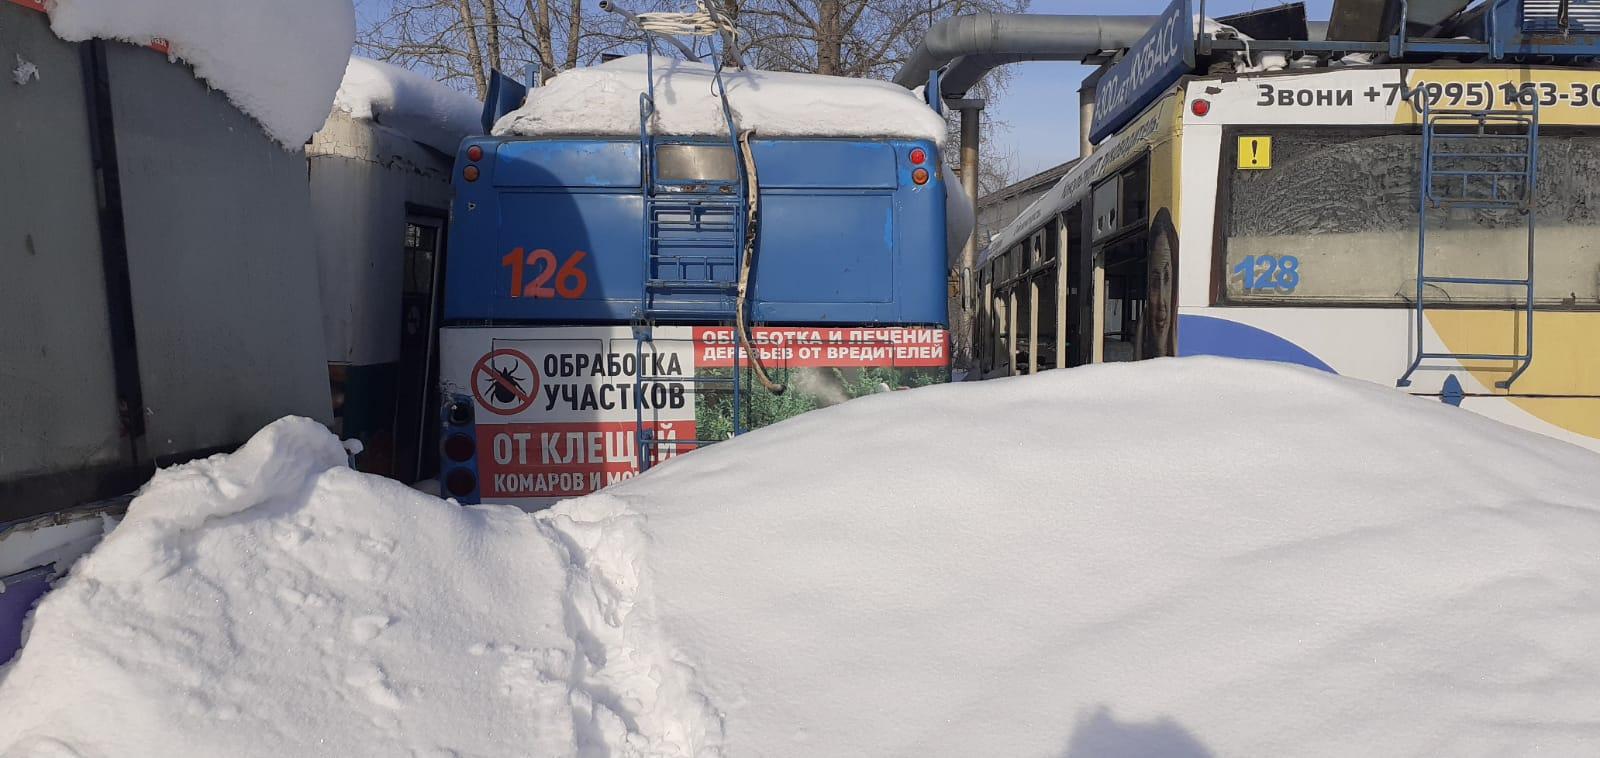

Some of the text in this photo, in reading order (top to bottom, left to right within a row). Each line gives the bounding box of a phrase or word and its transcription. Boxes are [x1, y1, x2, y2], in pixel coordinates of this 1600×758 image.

[1257, 83, 1353, 107] Звони
[1363, 82, 1401, 106] +7
[501, 247, 588, 299] 126
[1233, 254, 1299, 290] 128
[702, 329, 944, 345] ОББОТКА И ЛЕЧЕНИЕ
[543, 352, 682, 378] ОБРАБОТКА
[799, 347, 821, 359] ОТ
[827, 344, 943, 361] ВРЕДИТЕЛЕЙ
[543, 383, 686, 411] УЧАСТКОВ
[493, 422, 677, 468] ОТ КЛЕЩЙ
[494, 473, 584, 492] КОМАРОВ
[590, 472, 601, 491] И
